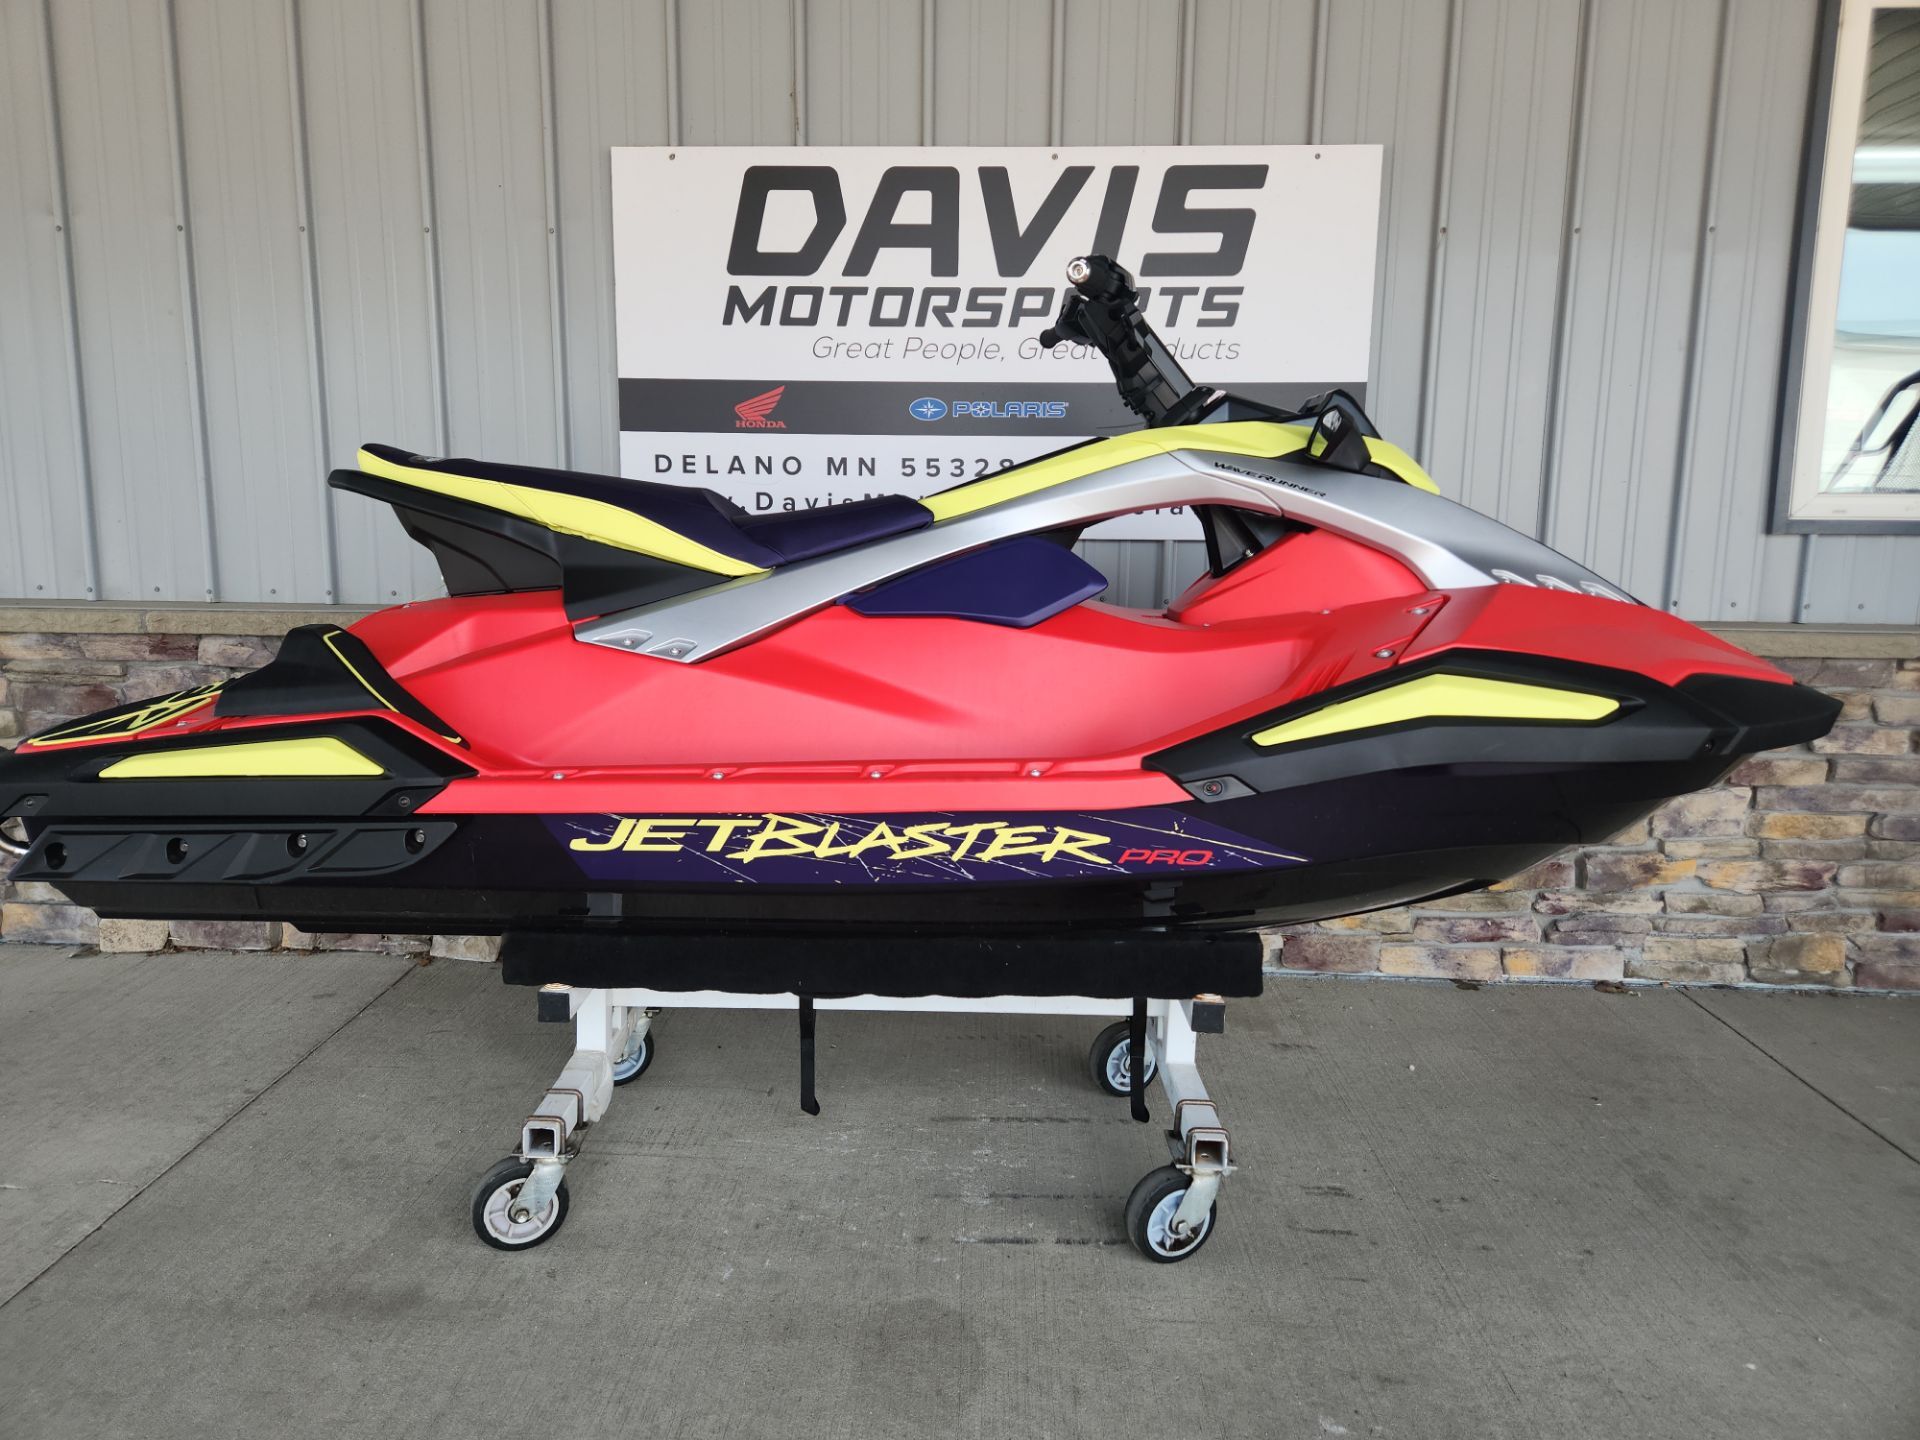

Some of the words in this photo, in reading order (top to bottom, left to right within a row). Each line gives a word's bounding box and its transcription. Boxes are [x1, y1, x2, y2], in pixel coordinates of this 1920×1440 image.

[726, 164, 1270, 278] DAVIS
[722, 285, 1245, 329] MOTORSPTS
[811, 335, 894, 360] Great
[902, 336, 1006, 366] People,
[1165, 336, 1242, 360] ducts
[952, 401, 1068, 419] POLARIS
[735, 419, 787, 429] HONDA
[654, 454, 803, 477] DELANO
[826, 456, 877, 477] MN
[1213, 461, 1327, 498] WAVERUNNER
[1117, 849, 1215, 866] PRO
